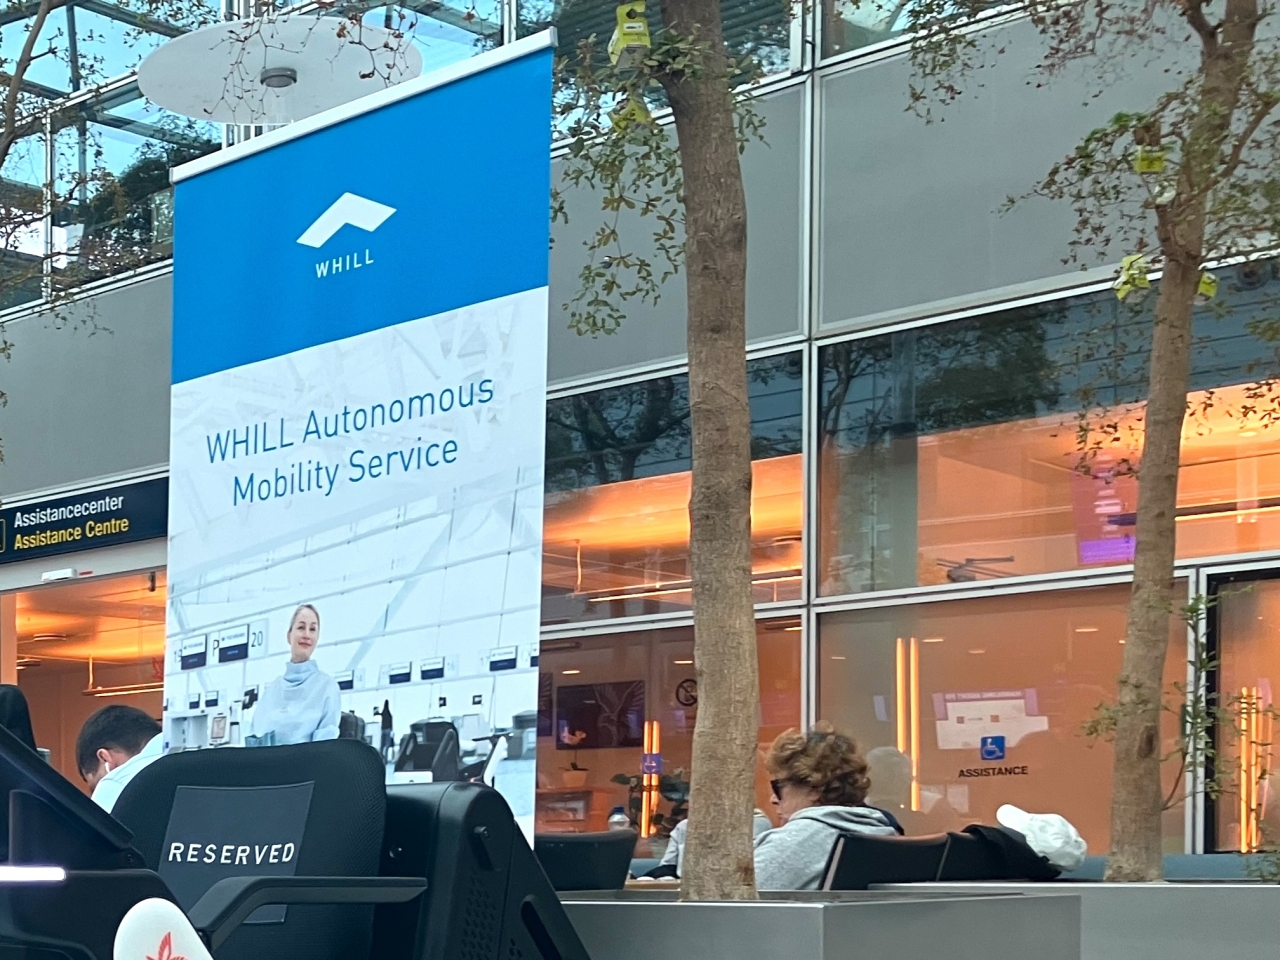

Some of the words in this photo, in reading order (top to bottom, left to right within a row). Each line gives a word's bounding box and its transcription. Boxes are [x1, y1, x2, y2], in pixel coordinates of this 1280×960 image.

[315, 248, 374, 278] WHILL
[206, 417, 294, 464] WHILL
[302, 377, 495, 443] Autonomous
[232, 460, 339, 507] Mobility
[348, 437, 458, 483] Service
[13, 495, 124, 528] Assistancecenter
[13, 523, 82, 550] Assistance
[85, 517, 129, 538] Centre
[250, 630, 264, 648] 20
[958, 765, 1028, 778] ASSISTANCE
[168, 841, 295, 865] RESERVED
